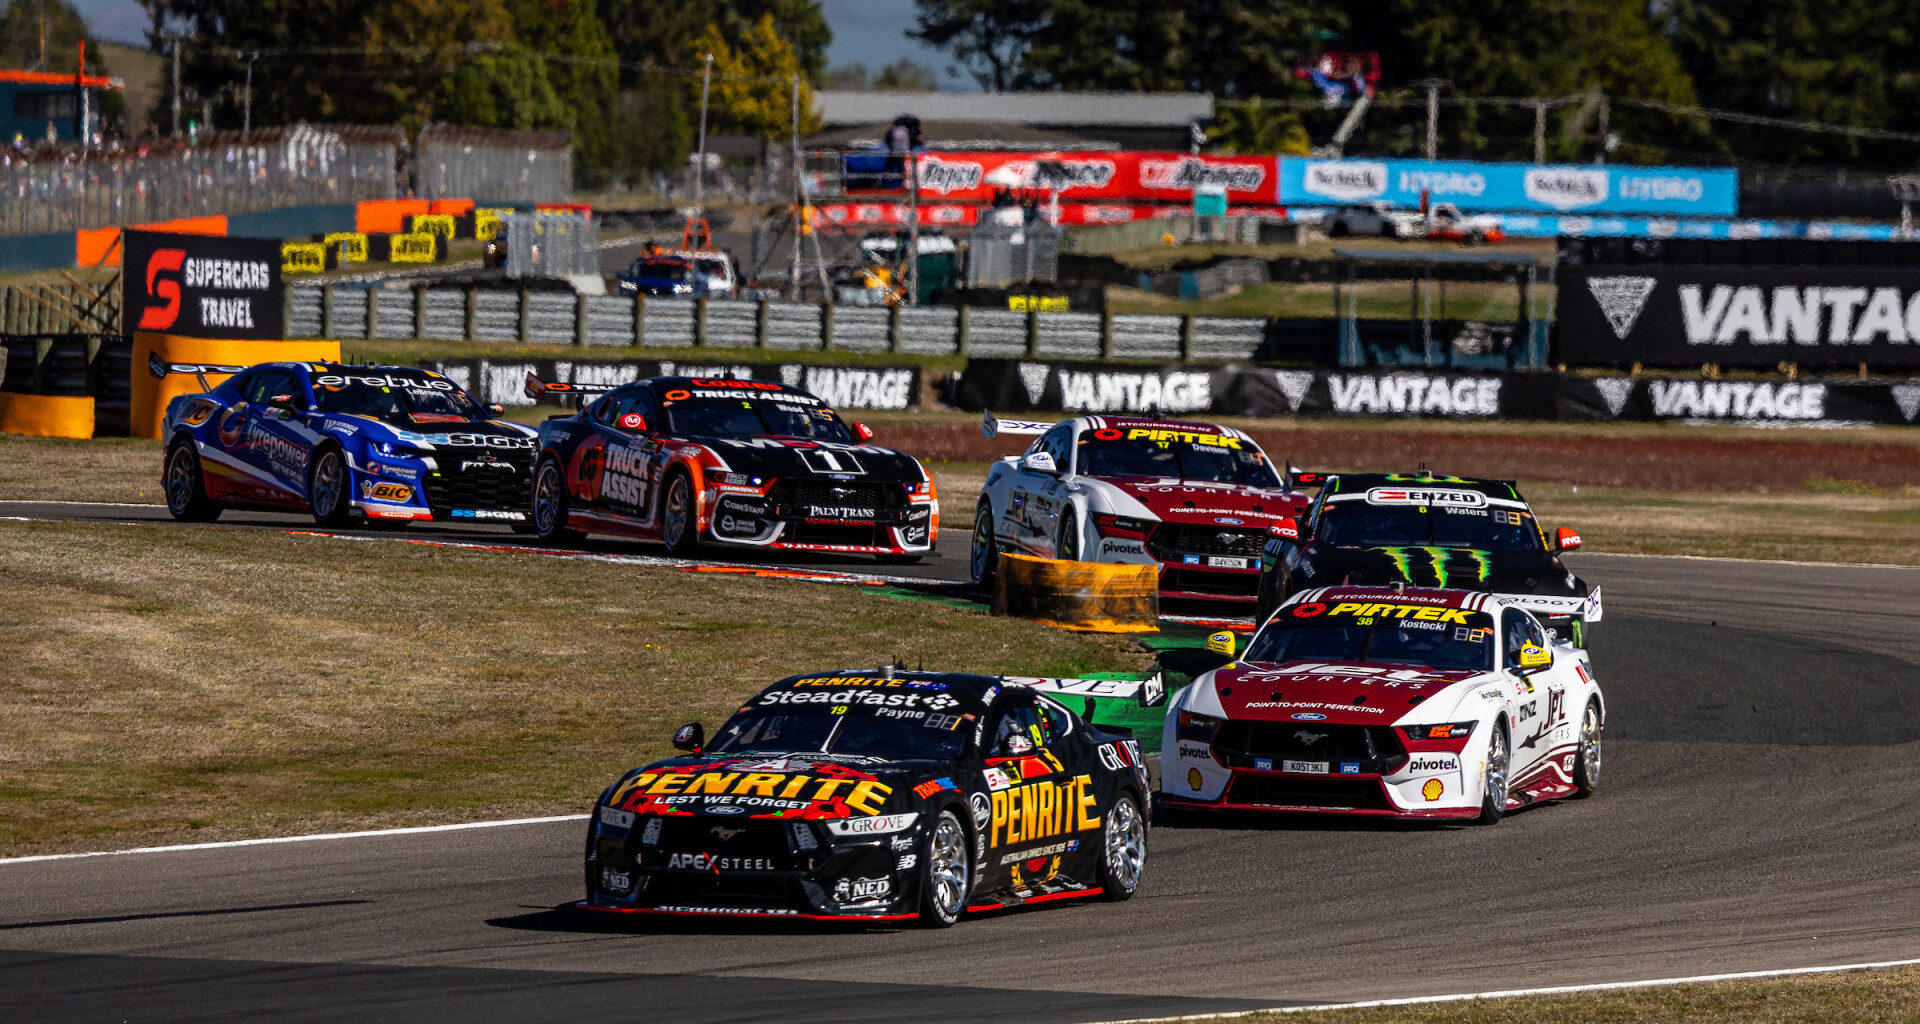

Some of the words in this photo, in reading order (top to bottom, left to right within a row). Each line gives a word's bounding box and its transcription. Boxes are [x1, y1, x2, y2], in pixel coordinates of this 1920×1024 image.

[1398, 168, 1487, 197] HYDRO
[1618, 174, 1704, 202] HYDRO
[185, 257, 269, 290] SUPERCARS
[200, 296, 255, 329] TRAVEL
[317, 374, 453, 391] erebus
[691, 379, 783, 391] Coates
[804, 367, 912, 410] VANTAGE
[692, 389, 758, 400] TRUCK
[759, 392, 819, 406] ASSIST
[1058, 370, 1213, 413] VANTAGE
[1328, 373, 1503, 415] VANTAGE
[1649, 379, 1827, 419] VANTAGE
[741, 401, 752, 410] 2
[776, 404, 804, 414] Wood
[247, 417, 308, 469] Tyrepower
[1127, 428, 1244, 450] PIRTEK
[1155, 441, 1170, 449] 17
[1192, 443, 1231, 455] Davison
[606, 443, 651, 480] TRUCK
[382, 464, 418, 477] Tyrepower
[601, 471, 648, 508] ASSIST
[1408, 491, 1476, 503] ENZED
[810, 505, 840, 517] PALM
[840, 507, 875, 518] TRANS
[1169, 507, 1233, 515] POINT-TO-POINT
[1234, 509, 1284, 520] PERFECTION
[1418, 506, 1428, 514] 6
[1446, 506, 1489, 517] Waters
[1270, 525, 1298, 537] RYCO
[1330, 594, 1448, 605] JETCOURIERS.CO.NZ
[1327, 602, 1477, 625] PIRTEK
[1356, 617, 1374, 626] 38
[1400, 619, 1447, 632] Kostecki
[792, 677, 906, 688] PENRITE
[1237, 675, 1426, 690] COURIERS
[758, 689, 921, 707] Steadfast
[830, 705, 849, 715] 19
[875, 707, 926, 719] Payne
[1326, 703, 1385, 714] PERFECTION
[1098, 738, 1144, 771] GROVE
[609, 773, 893, 816] PENRITE
[653, 796, 700, 805] LEST
[704, 796, 735, 804] WE
[736, 797, 812, 809] FORGET
[990, 774, 1101, 848] PENRITE
[852, 816, 904, 833] GROVE
[668, 852, 720, 875] APEX
[721, 858, 775, 870] STEEL
[611, 873, 630, 889] NED
[852, 880, 890, 898] NED
